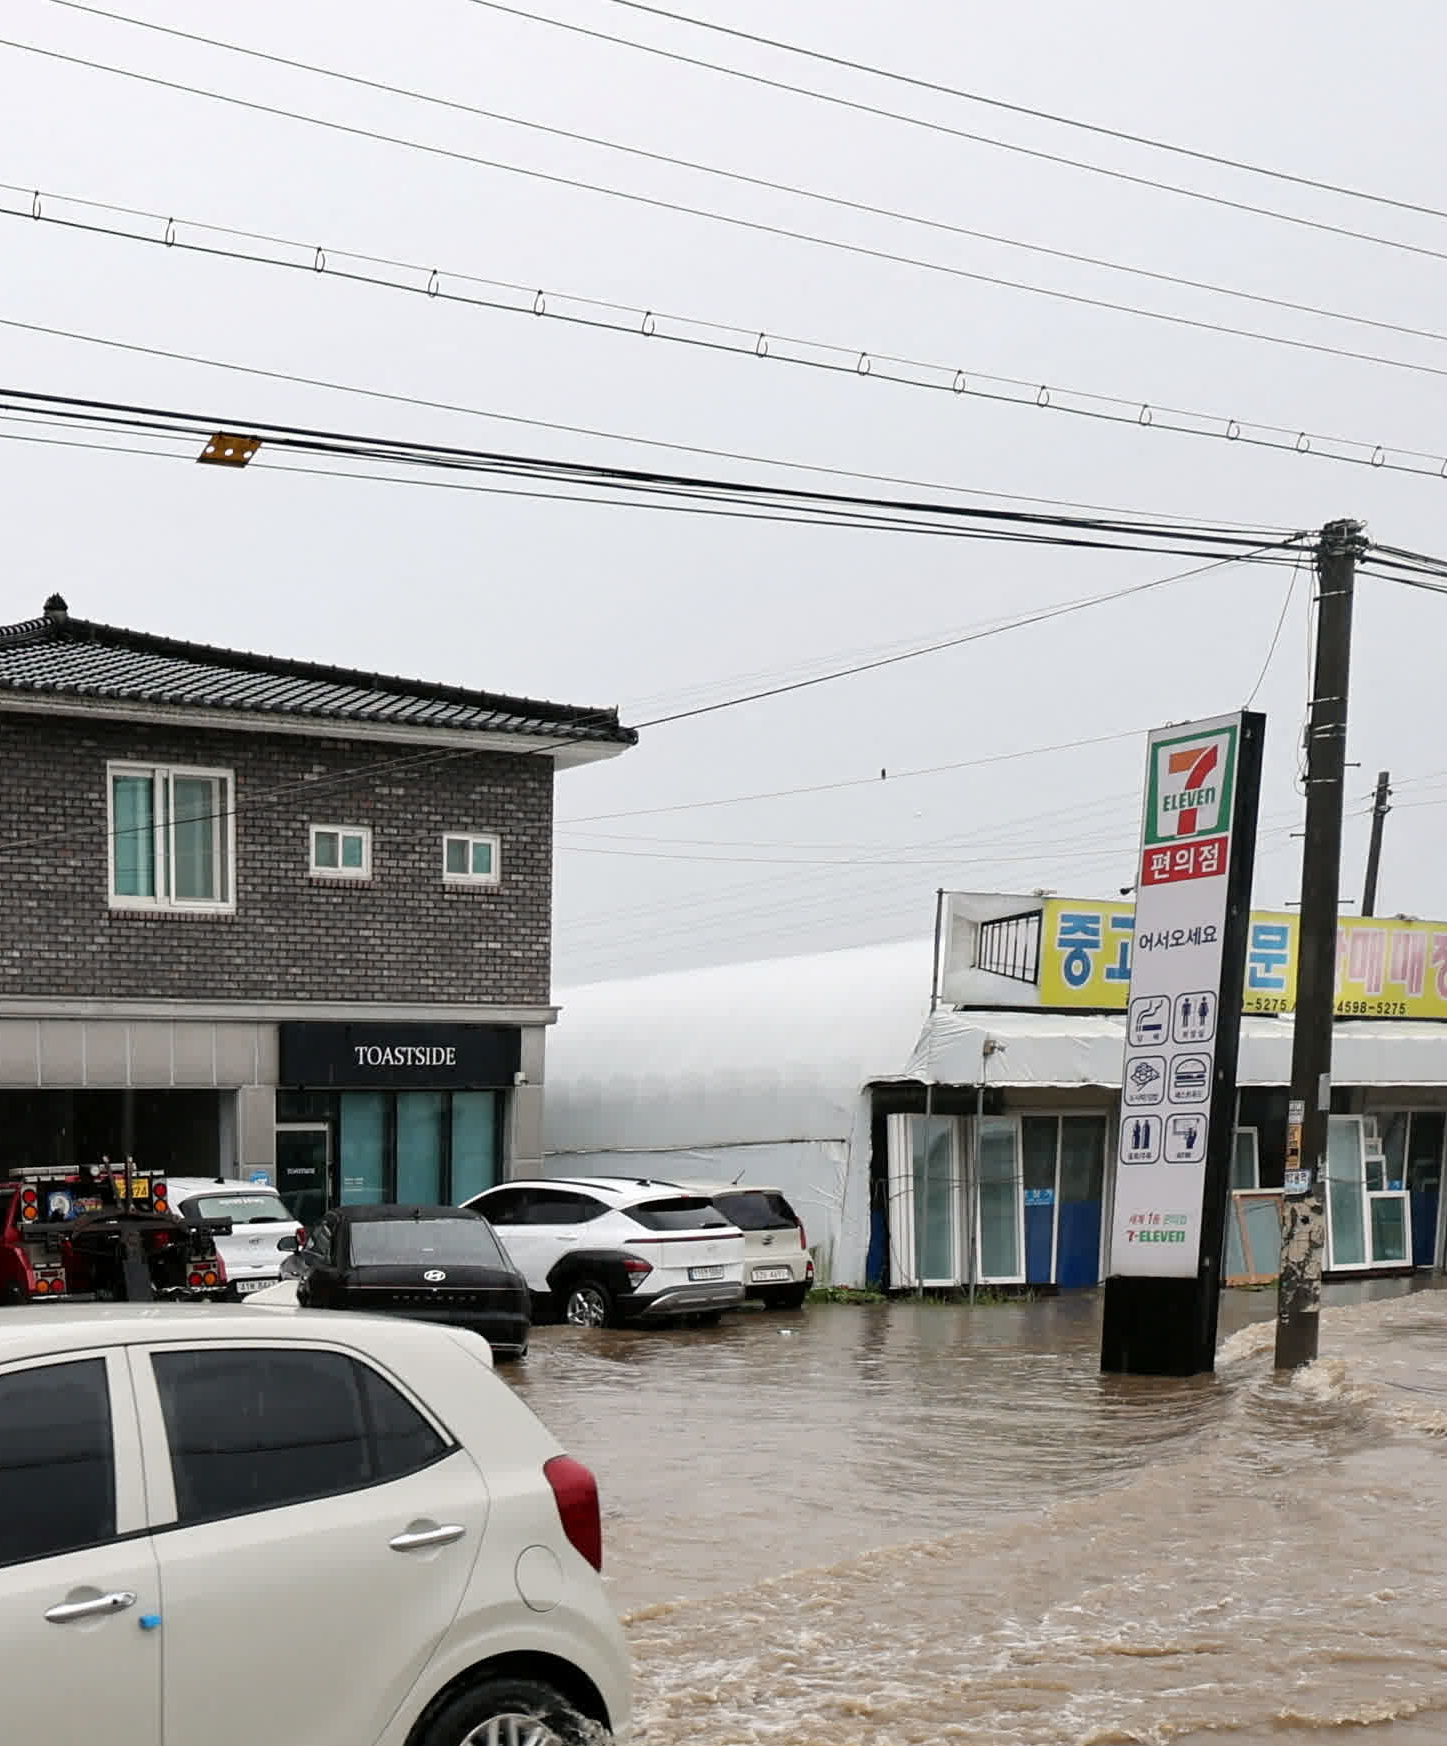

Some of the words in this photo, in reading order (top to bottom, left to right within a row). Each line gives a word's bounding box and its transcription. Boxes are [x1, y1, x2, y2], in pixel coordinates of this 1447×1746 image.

[1169, 744, 1219, 835] 7
[1150, 843, 1220, 880] 편의점
[1139, 925, 1218, 951] 어서오세요
[1241, 998, 1287, 1012] -5275
[354, 1046, 457, 1066] TOASTSIDE
